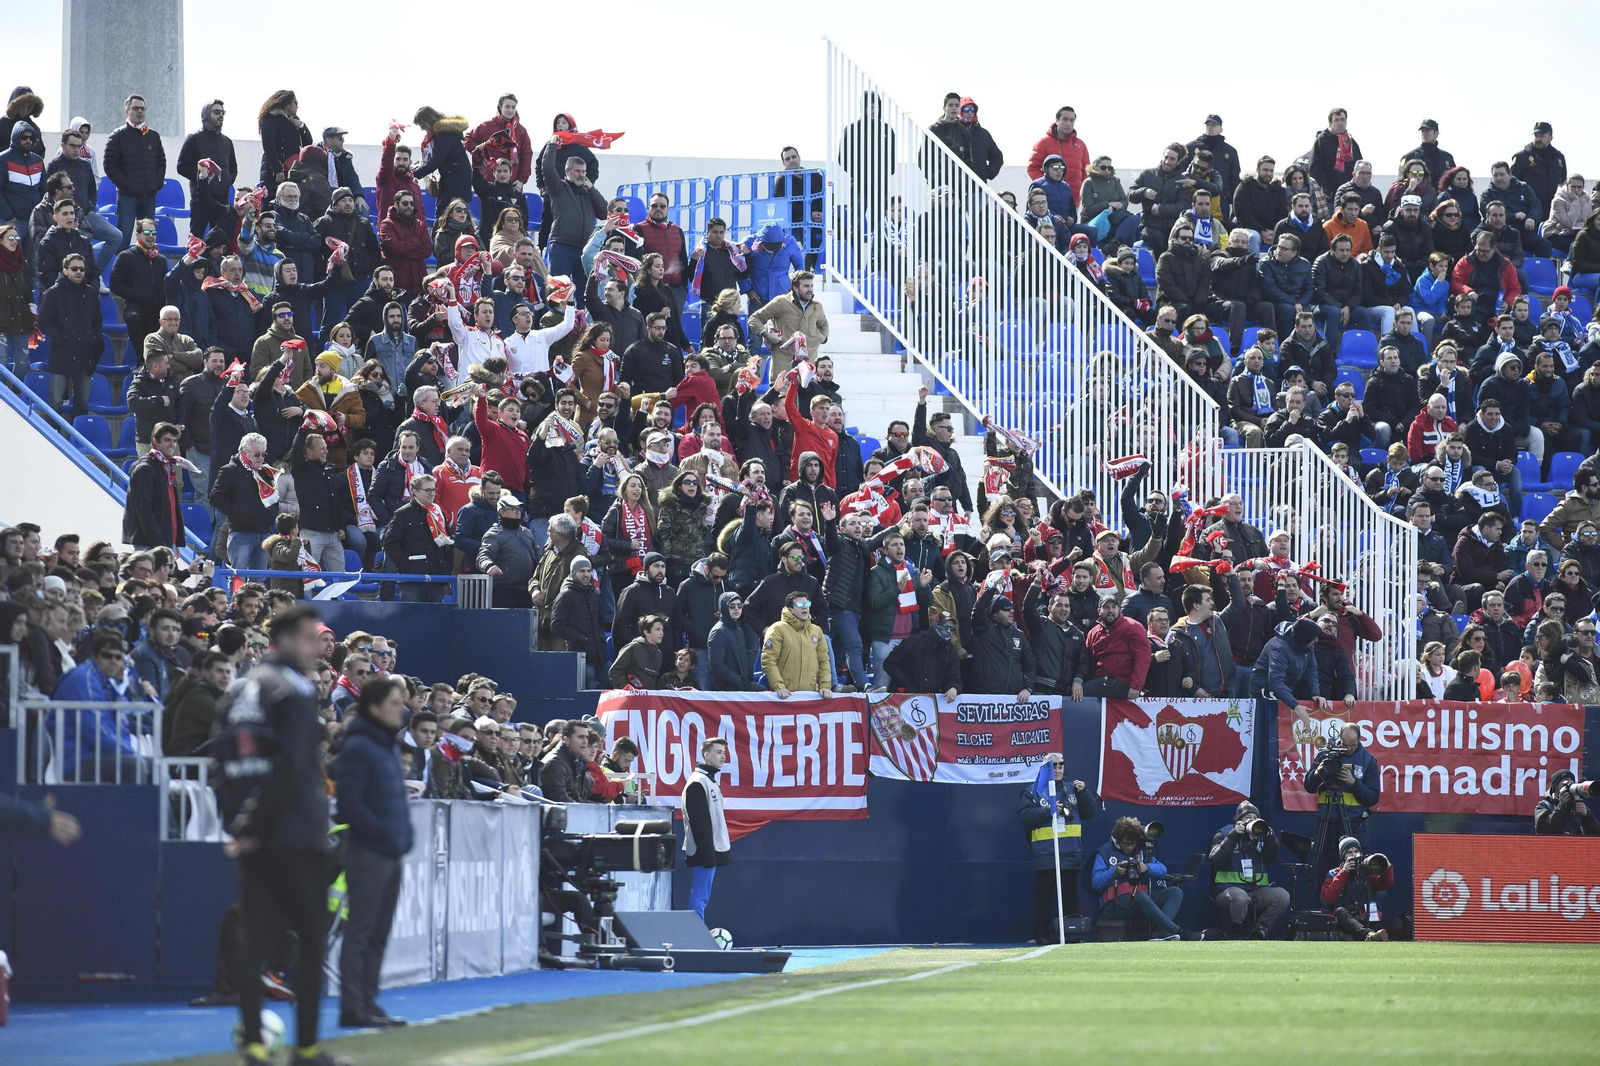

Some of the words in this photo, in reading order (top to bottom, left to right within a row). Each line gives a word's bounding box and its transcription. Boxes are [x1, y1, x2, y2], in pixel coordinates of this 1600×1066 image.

[956, 701, 1050, 723] SEVILLISTAS
[956, 733, 993, 746] ELCHE
[1011, 729, 1050, 746] ALICANTE
[1357, 708, 1581, 754] sevillismo
[600, 709, 706, 786] ENGO
[717, 714, 740, 787] A
[745, 711, 866, 788] VERTE
[957, 755, 972, 765] más
[1380, 754, 1579, 797] nmadri
